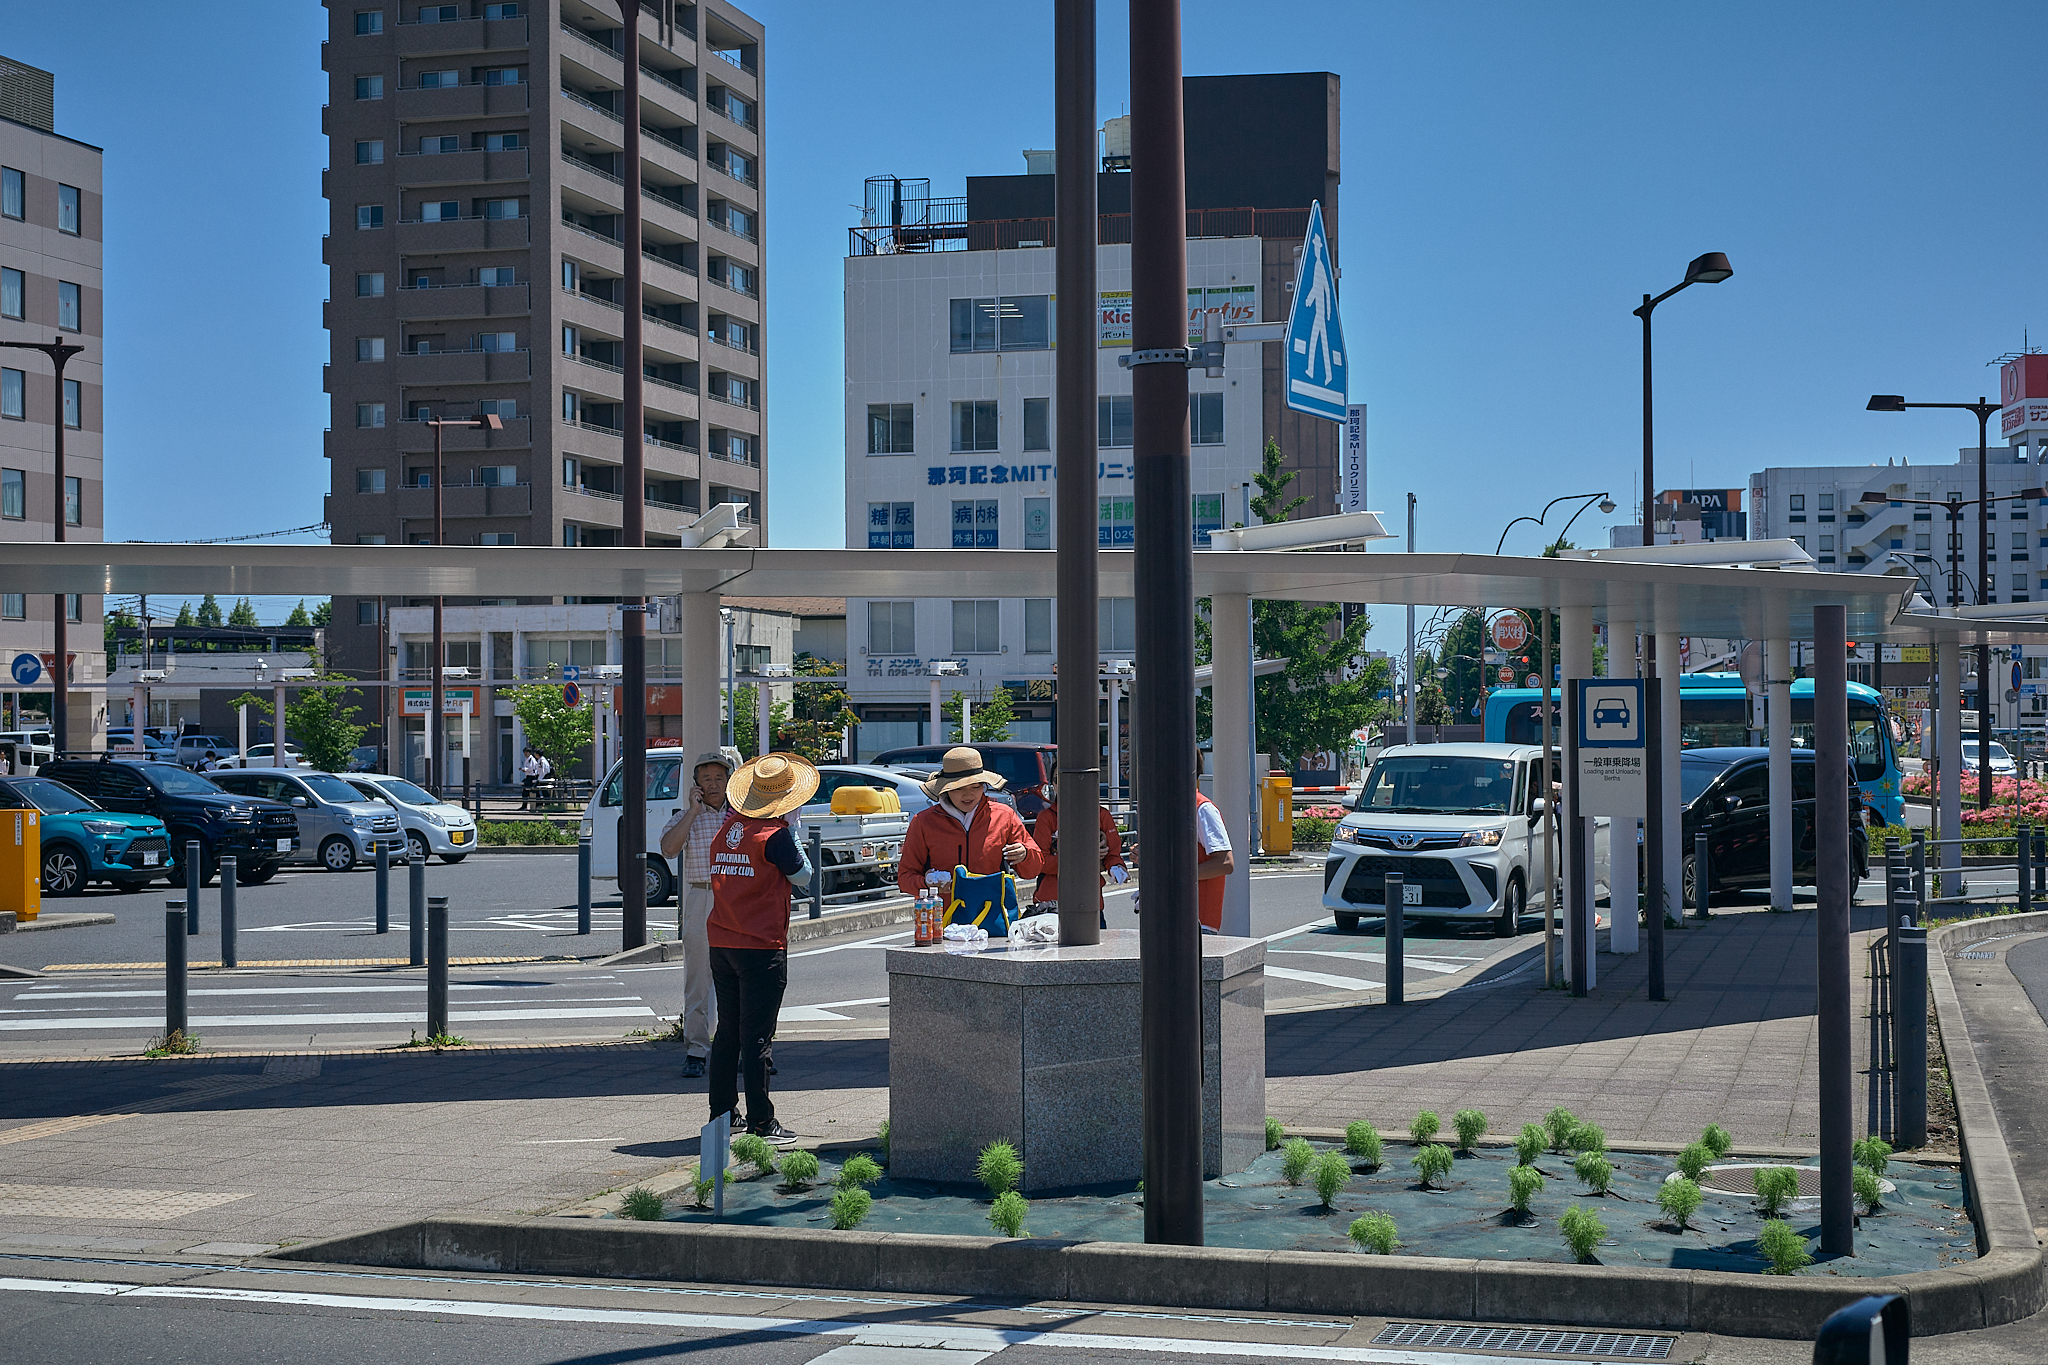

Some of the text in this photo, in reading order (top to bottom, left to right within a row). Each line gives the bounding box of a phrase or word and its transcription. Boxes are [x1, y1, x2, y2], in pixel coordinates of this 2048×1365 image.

[1349, 409, 1360, 508] 那珂記念MITOクリニック
[1690, 495, 1721, 508] APA
[1529, 678, 1539, 686] 50
[1583, 757, 1641, 767] 一般車乗降場
[1615, 768, 1642, 776] Unloading
[738, 866, 755, 877] CLUB
[1403, 892, 1419, 903] -31
